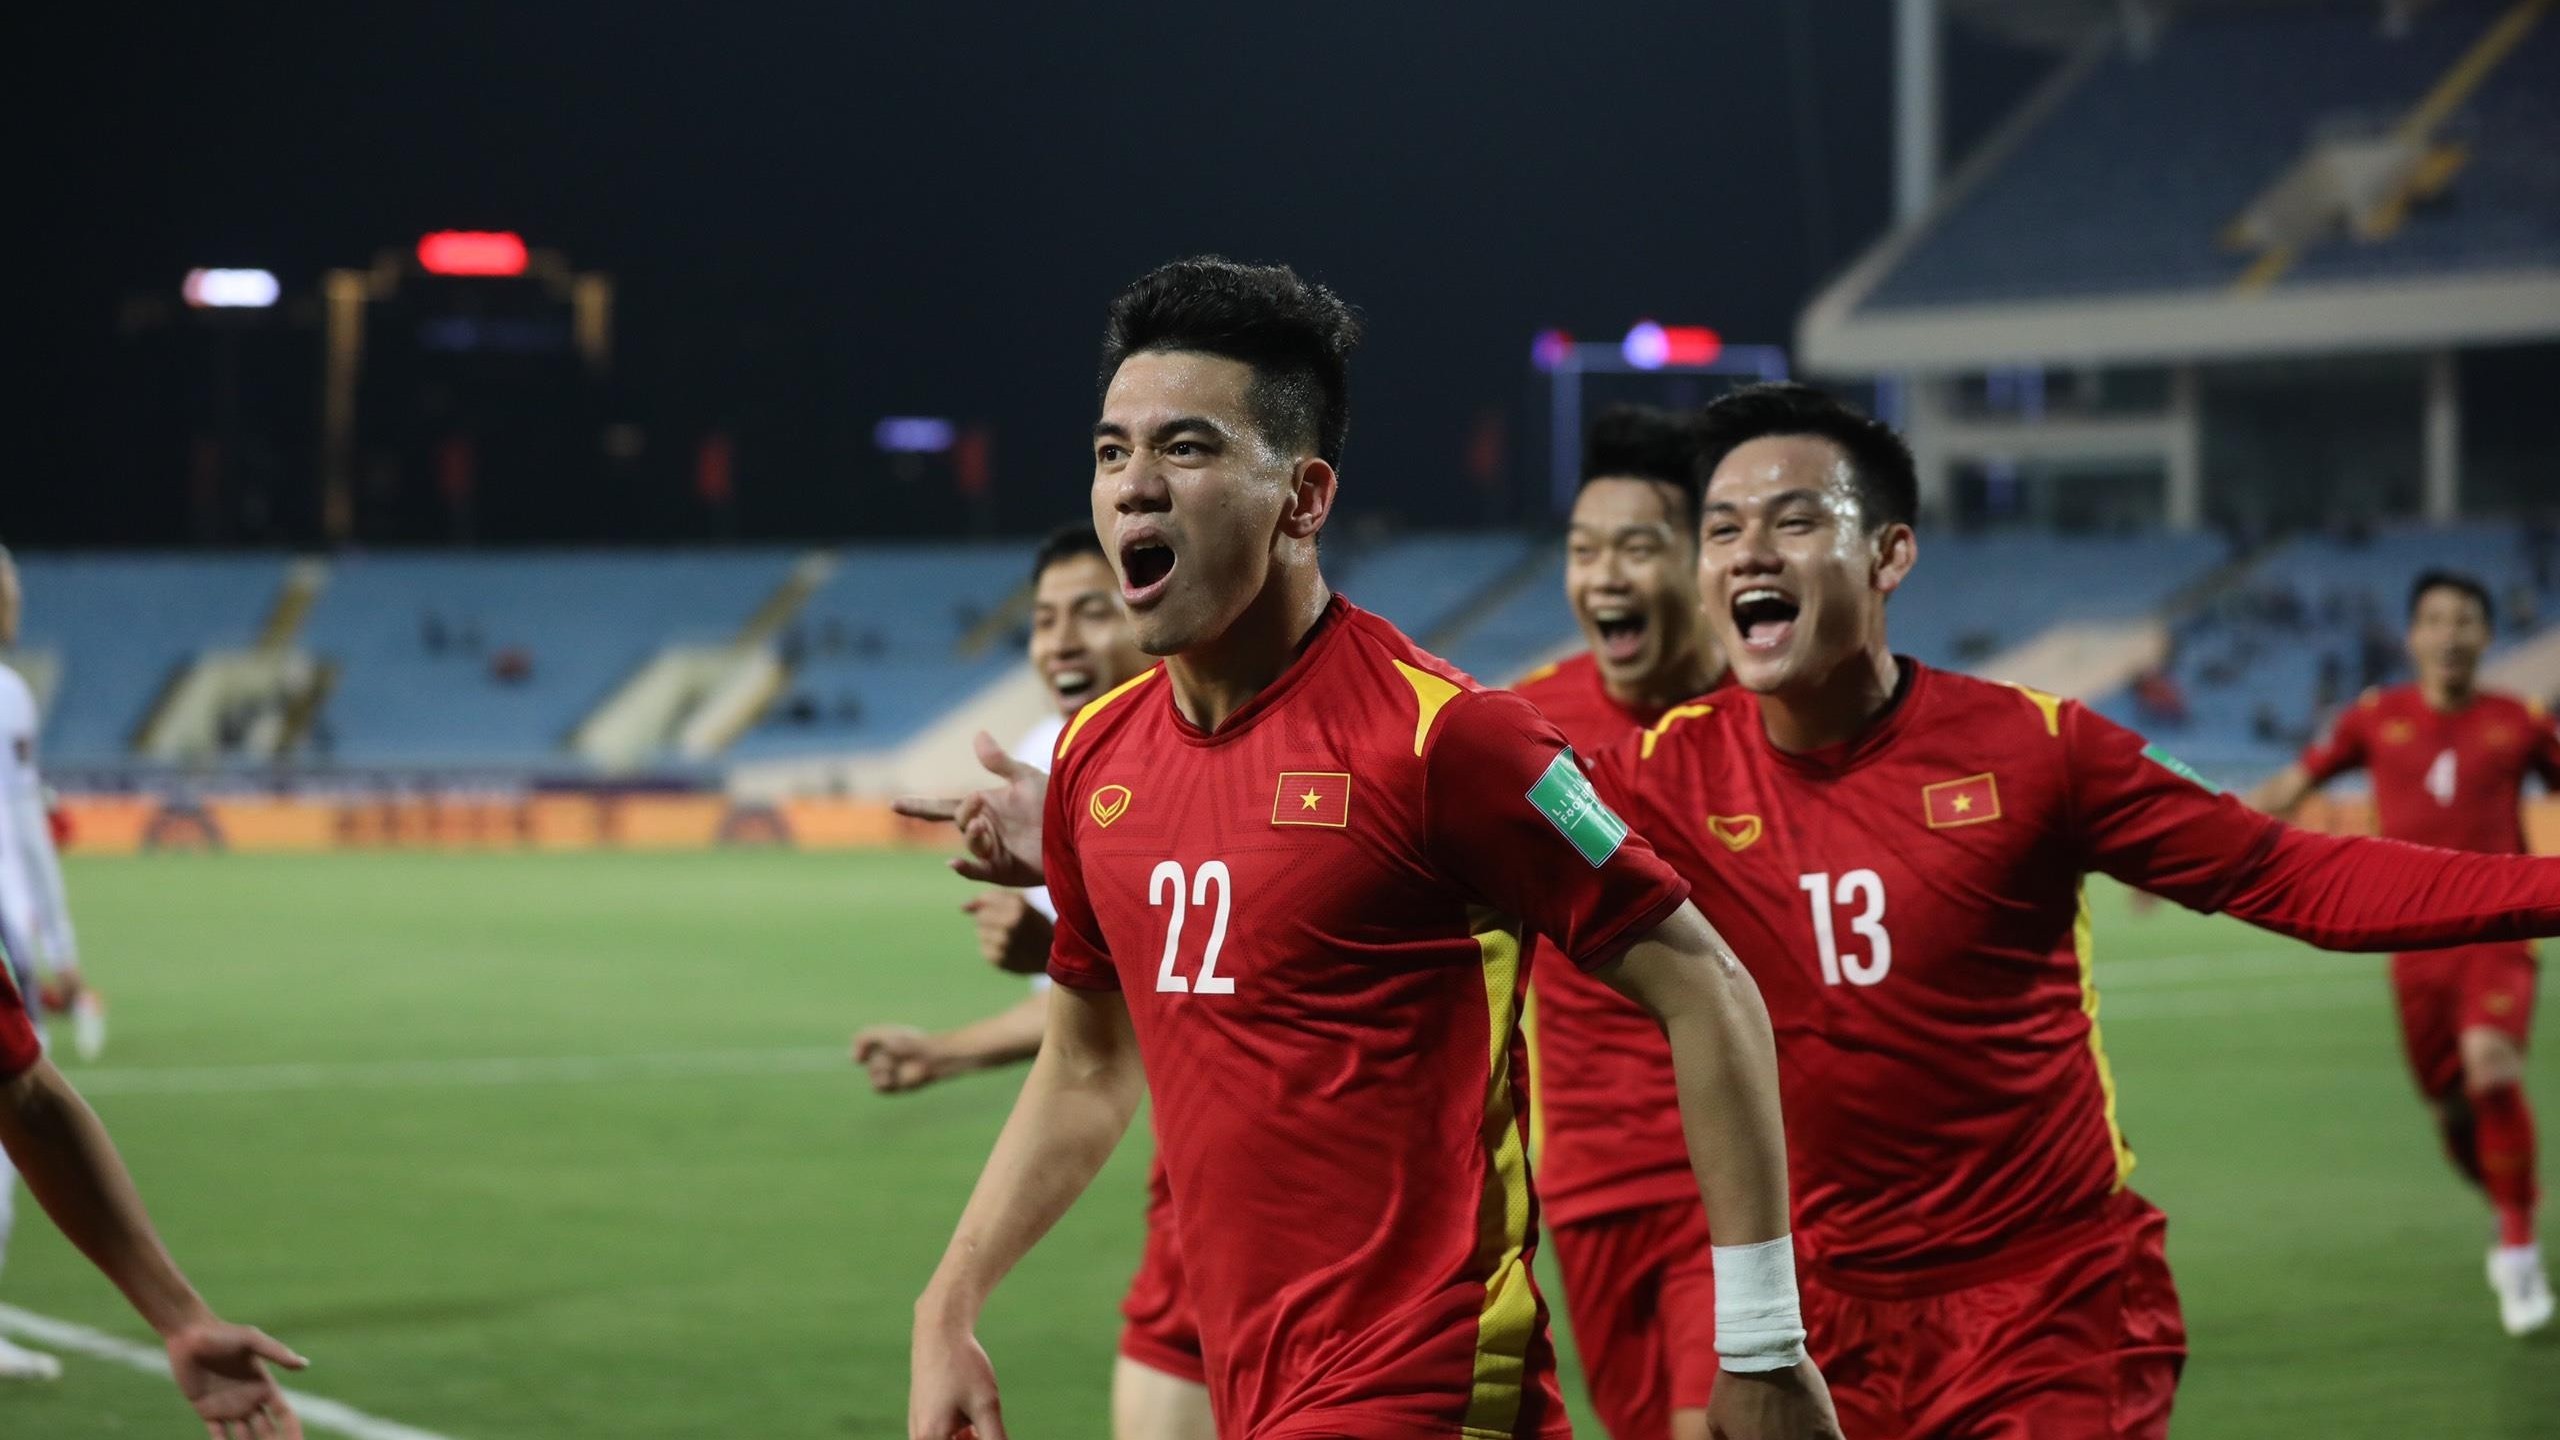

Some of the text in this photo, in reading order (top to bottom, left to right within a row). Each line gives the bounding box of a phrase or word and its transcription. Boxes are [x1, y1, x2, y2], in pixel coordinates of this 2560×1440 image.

[2424, 747, 2459, 807] 4
[1149, 860, 1235, 994] 22
[1799, 868, 1892, 987] 13
